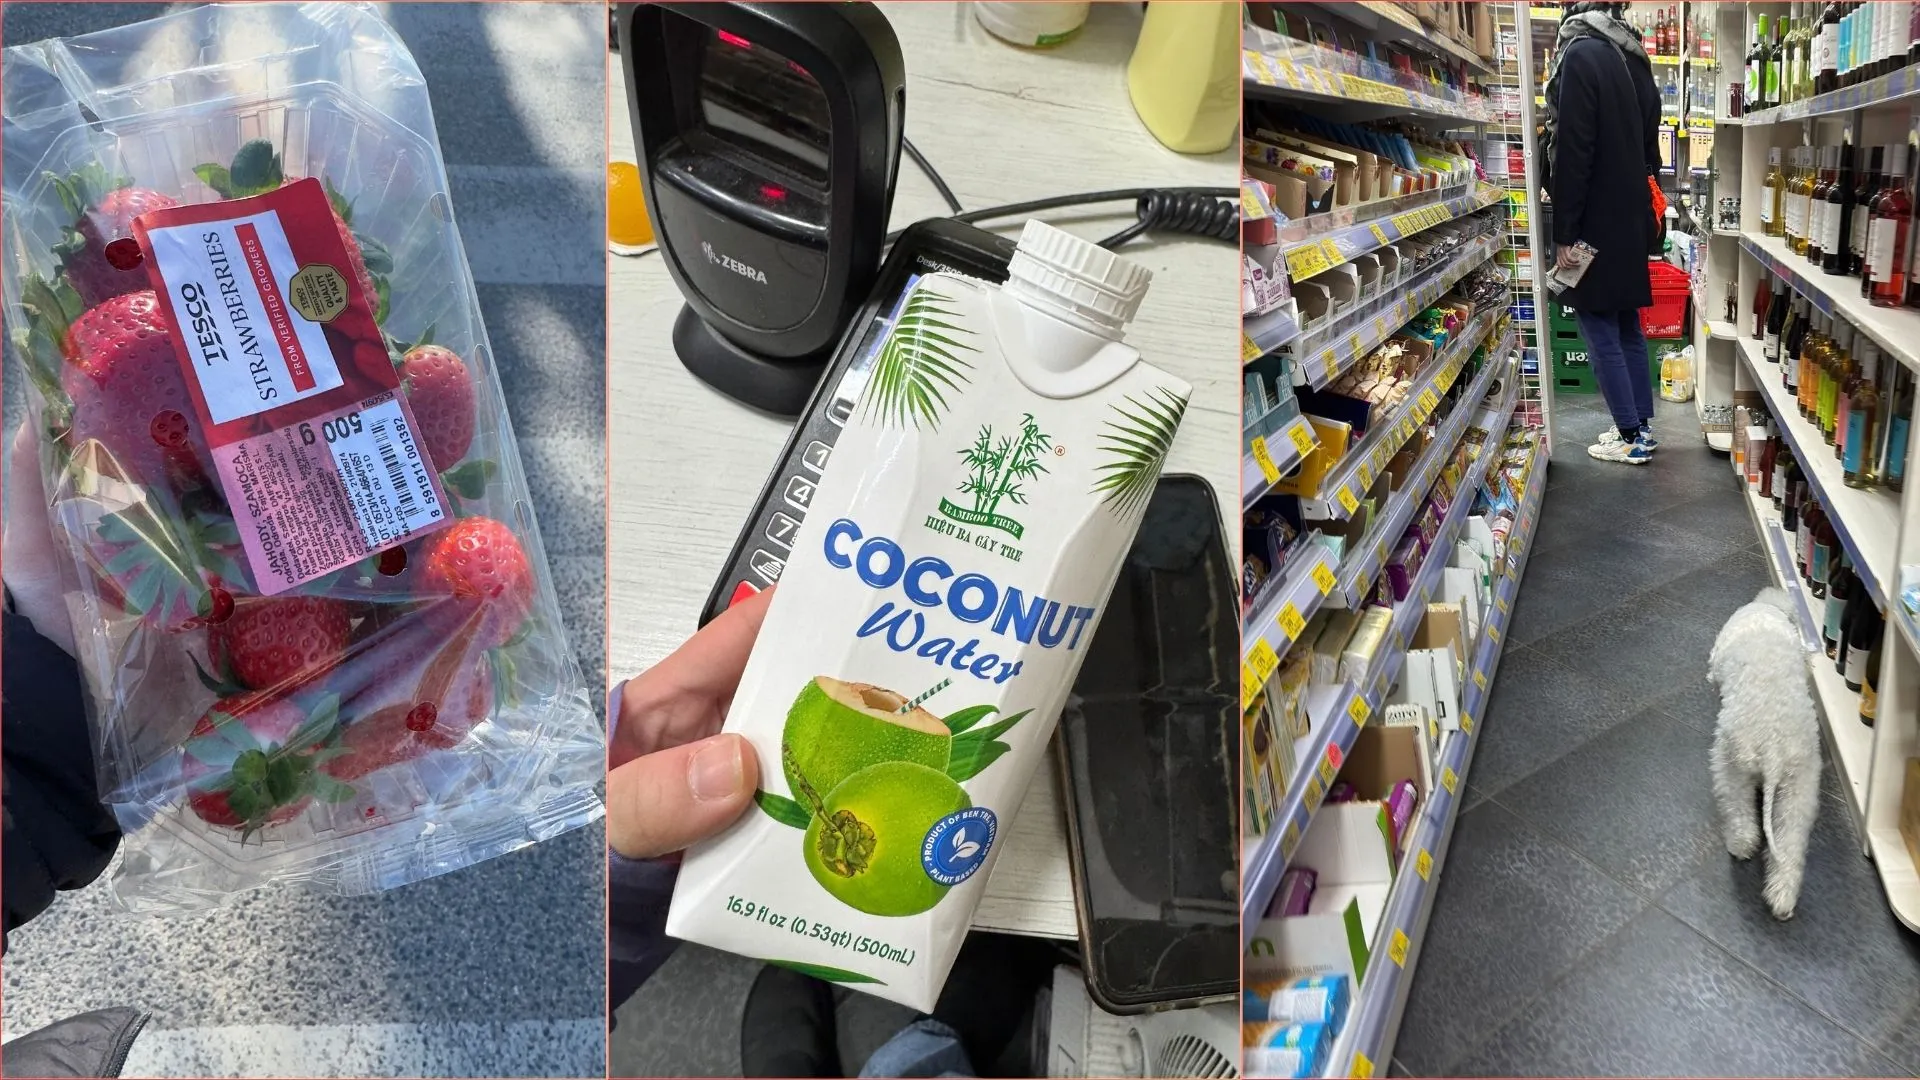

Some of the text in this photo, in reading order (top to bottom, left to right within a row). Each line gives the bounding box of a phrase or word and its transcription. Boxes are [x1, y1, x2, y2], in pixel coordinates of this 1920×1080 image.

[325, 272, 339, 296] TASTE
[721, 256, 768, 286] ZEBRA
[246, 239, 304, 376] FROM VERIFIED GROWERS
[316, 274, 333, 308] QUALITY
[182, 283, 221, 366] TESCO
[203, 231, 277, 401] STRAWBERRIES
[298, 412, 363, 446] 500 g
[238, 443, 258, 485] MARISMA
[339, 452, 357, 487] 21/40974
[365, 463, 374, 472] 13
[393, 416, 440, 517] 8 591911 001382
[817, 449, 828, 466] 1
[230, 455, 261, 518] SZAMÓCA
[793, 486, 808, 504] 4
[378, 494, 395, 524] FCC-01
[944, 504, 1019, 533] BAMBOO TREE
[360, 507, 381, 548] Andalucia
[378, 524, 392, 545] LOT:
[776, 519, 794, 537] 7
[956, 527, 971, 543] BA
[1000, 544, 1023, 562] TRE
[823, 518, 1095, 651] COCONUT
[857, 602, 1024, 685] Water
[925, 822, 947, 861] PRODUCT
[948, 815, 960, 824] OF
[930, 868, 954, 882] PLANT
[726, 895, 915, 966] 16.9 fl oz (0.53qt) (500mL)
